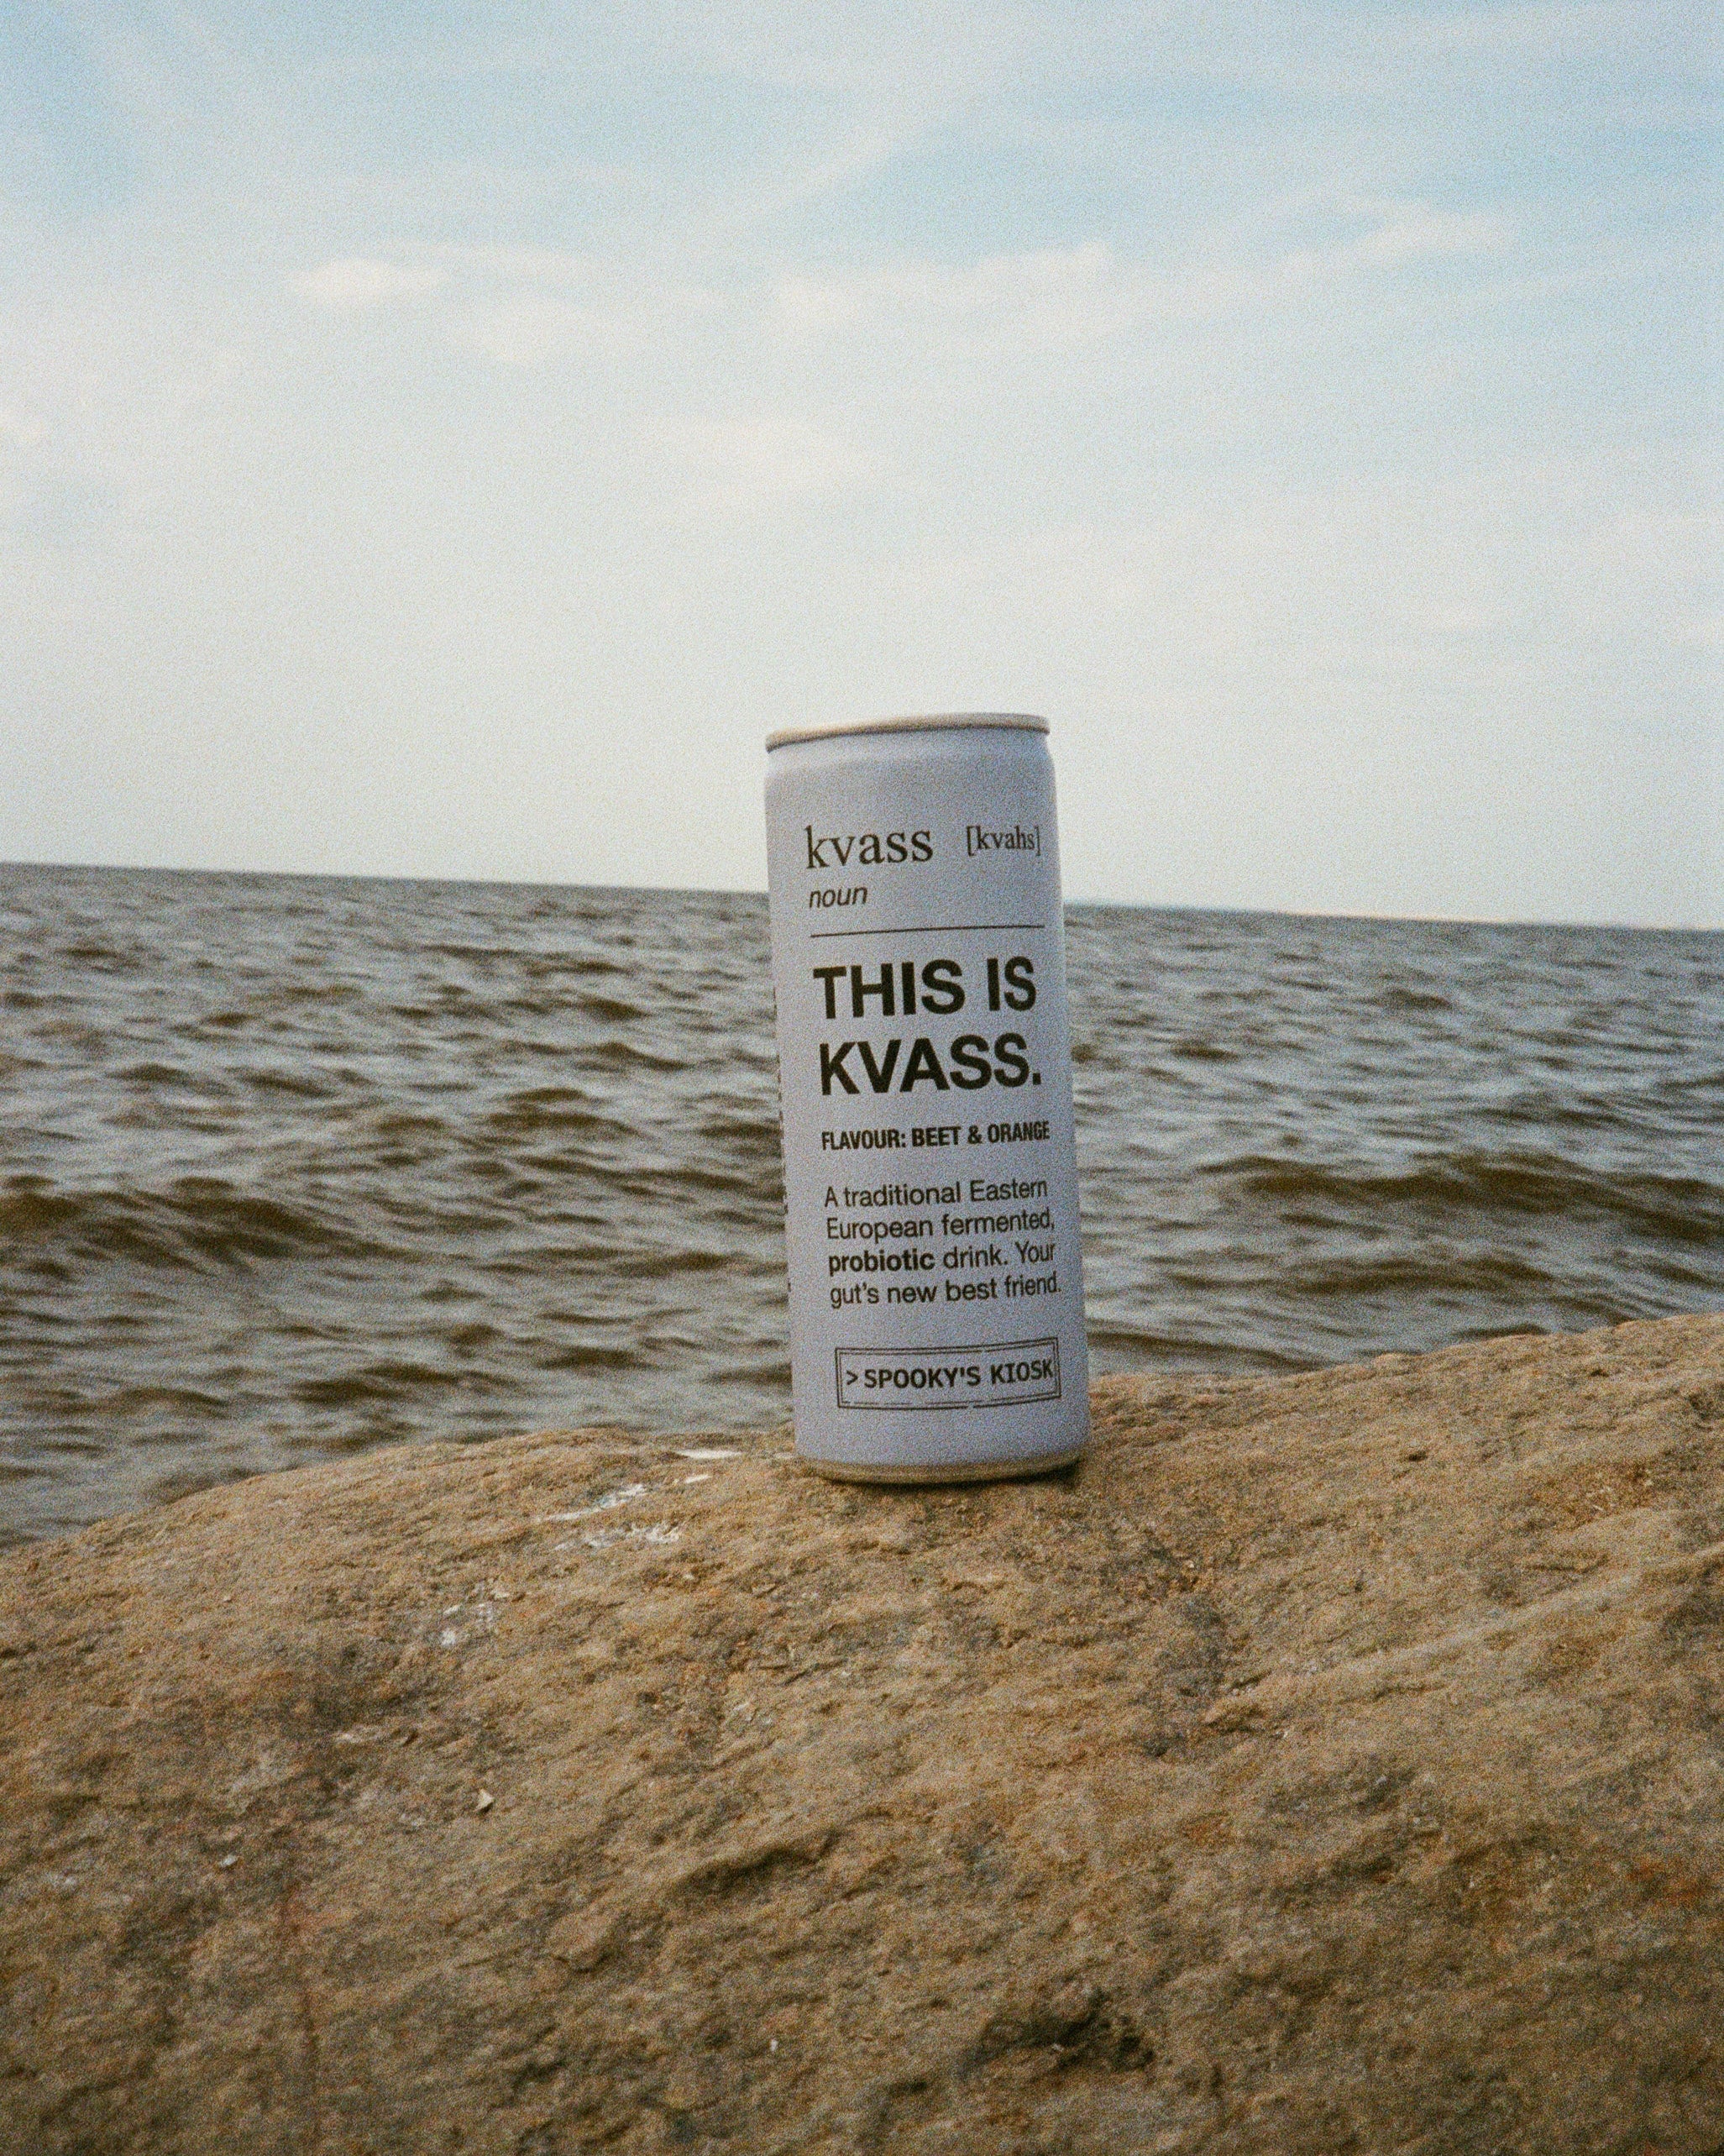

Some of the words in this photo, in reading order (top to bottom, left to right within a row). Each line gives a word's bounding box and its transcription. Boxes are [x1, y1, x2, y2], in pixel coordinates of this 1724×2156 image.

[804, 825, 933, 869] kvass
[967, 826, 1040, 857] [kvahs]
[809, 886, 867, 908] noun
[812, 959, 965, 1020] THIS
[986, 956, 1037, 1012] IS
[819, 1033, 1042, 1096] KVASS.
[820, 1129, 906, 1151] FLAVOUR:
[911, 1125, 962, 1148] BEET
[967, 1125, 983, 1145] &
[988, 1120, 1051, 1144] ORANGE
[824, 1186, 839, 1208] A
[843, 1180, 962, 1208] traditional
[969, 1178, 1048, 1203] Eastern
[826, 1217, 934, 1245] European
[941, 1207, 1055, 1235] fermented,
[829, 1247, 935, 1277] probiotic
[942, 1243, 1009, 1270] drink.
[1014, 1241, 1056, 1267] Your
[830, 1282, 880, 1310] gut's
[887, 1285, 938, 1305] new
[945, 1277, 998, 1303] best
[1003, 1271, 1062, 1298] friend.
[863, 1367, 982, 1389] SPOOKY'S
[989, 1358, 1054, 1386] KIOSK
